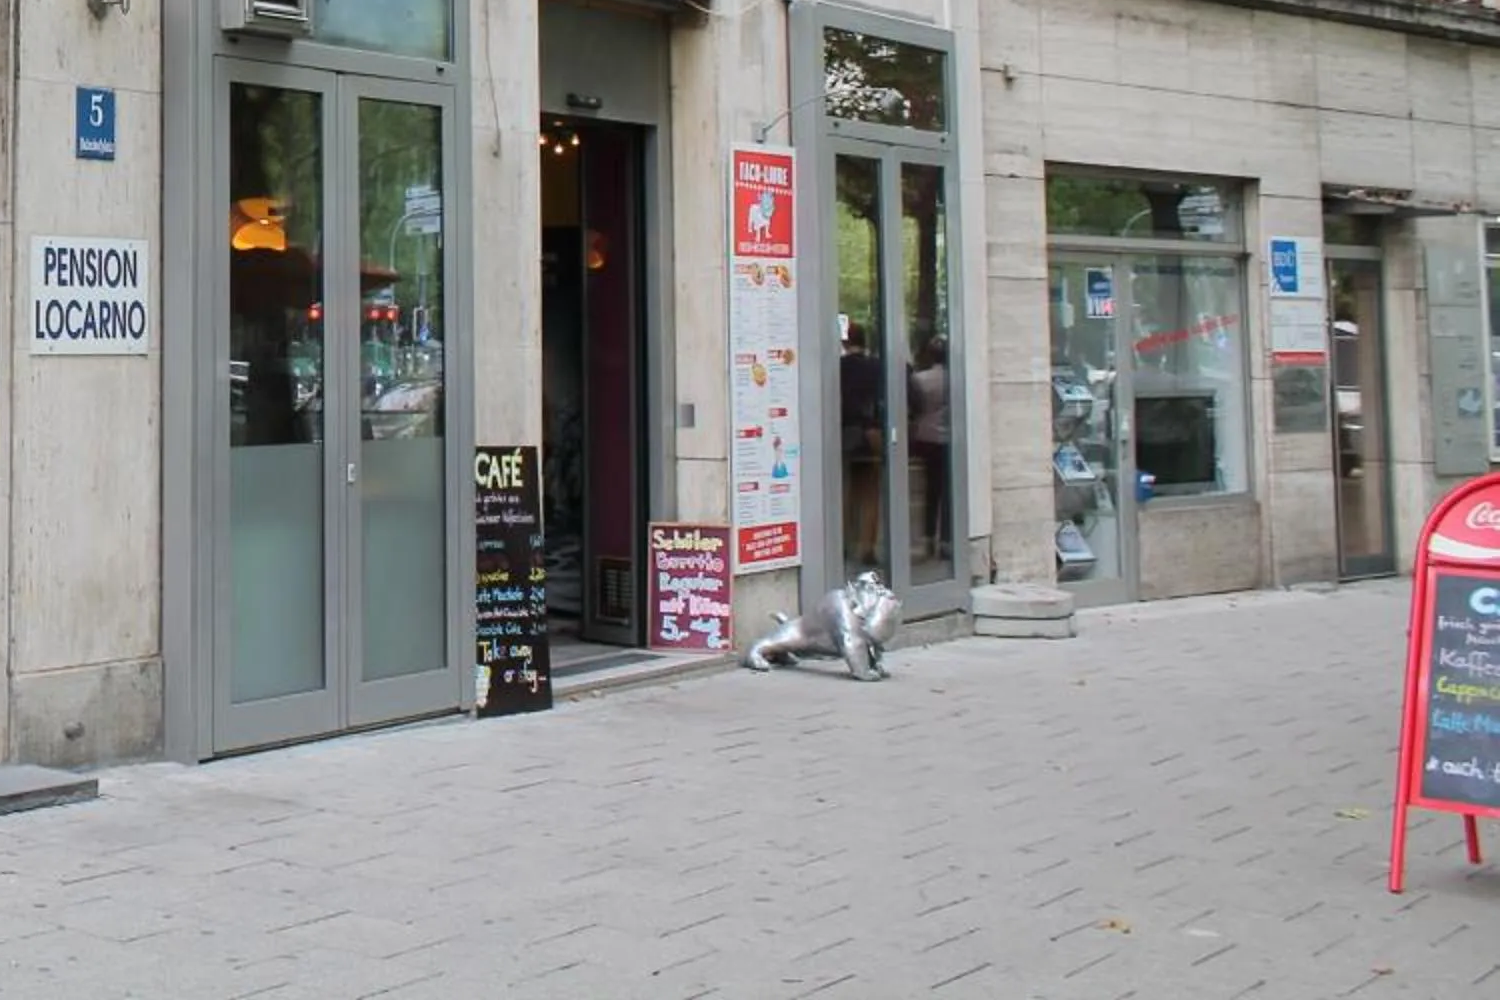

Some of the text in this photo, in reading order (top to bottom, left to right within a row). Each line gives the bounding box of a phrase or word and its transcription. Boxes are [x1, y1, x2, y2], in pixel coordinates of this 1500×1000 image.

[89, 93, 104, 128] 5
[43, 247, 138, 289] PENSION
[35, 299, 146, 340] LOCARNO
[476, 447, 523, 489] CAFÉ
